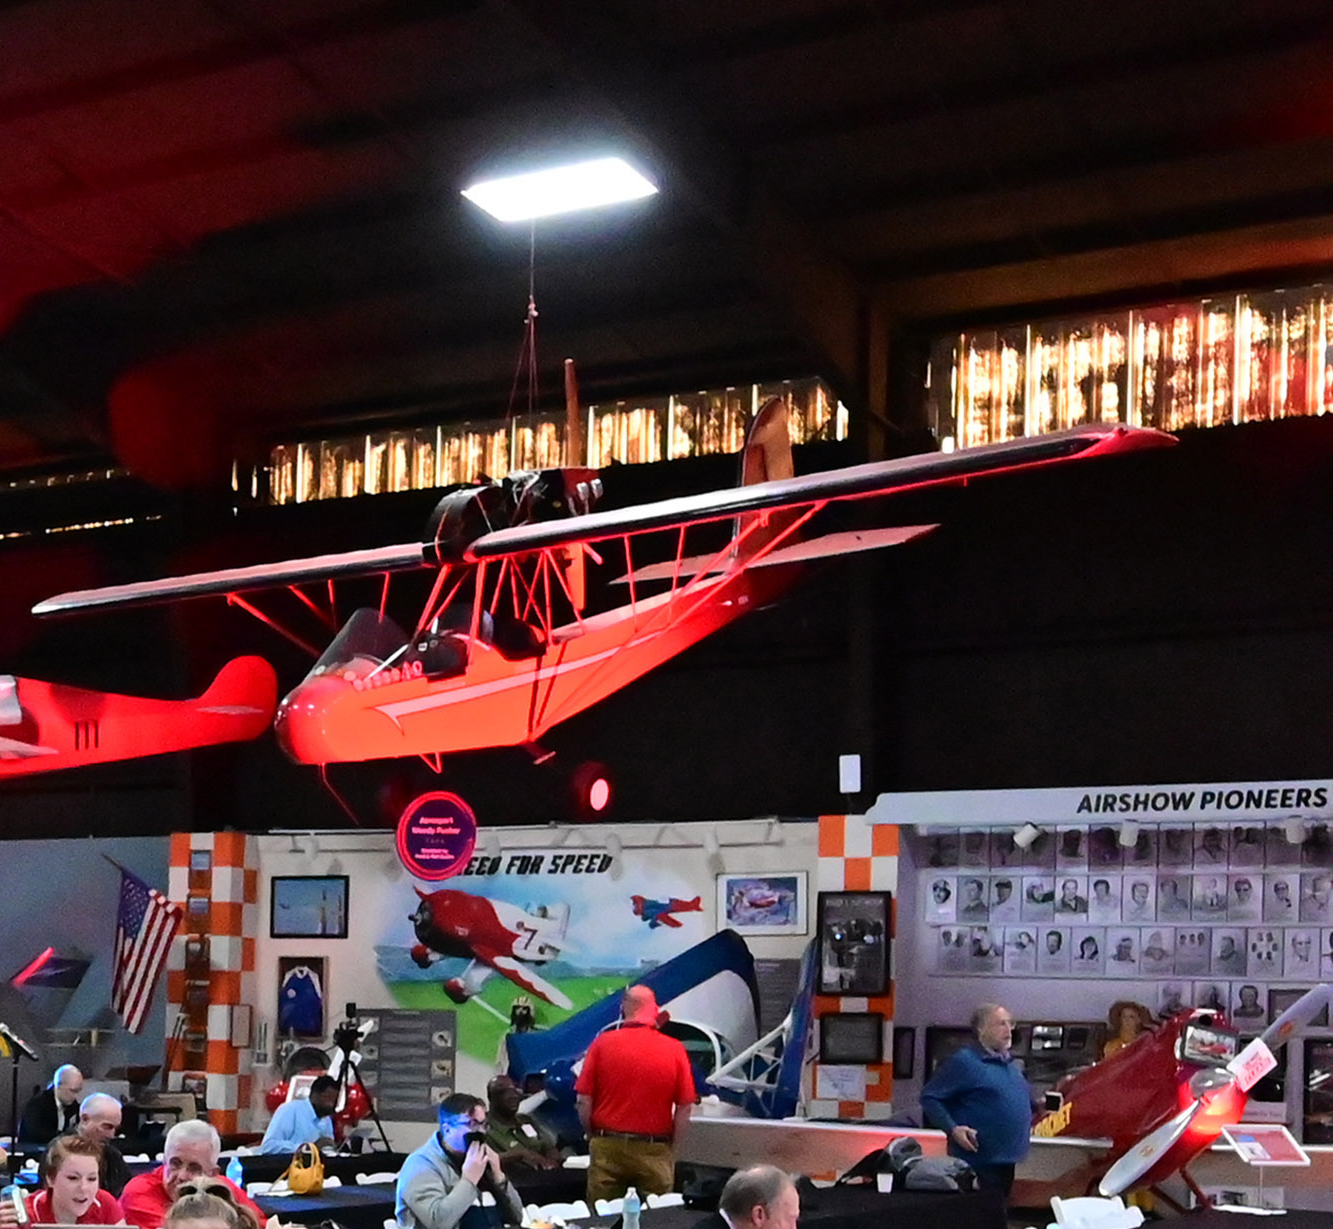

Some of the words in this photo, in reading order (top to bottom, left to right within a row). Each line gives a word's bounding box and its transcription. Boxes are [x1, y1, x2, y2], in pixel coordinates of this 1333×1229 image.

[1076, 792, 1195, 814] AIRSHOW
[1199, 787, 1329, 811] PIONEERS
[458, 856, 503, 877] EED
[505, 855, 545, 876] FOR
[548, 853, 613, 875] SPEED
